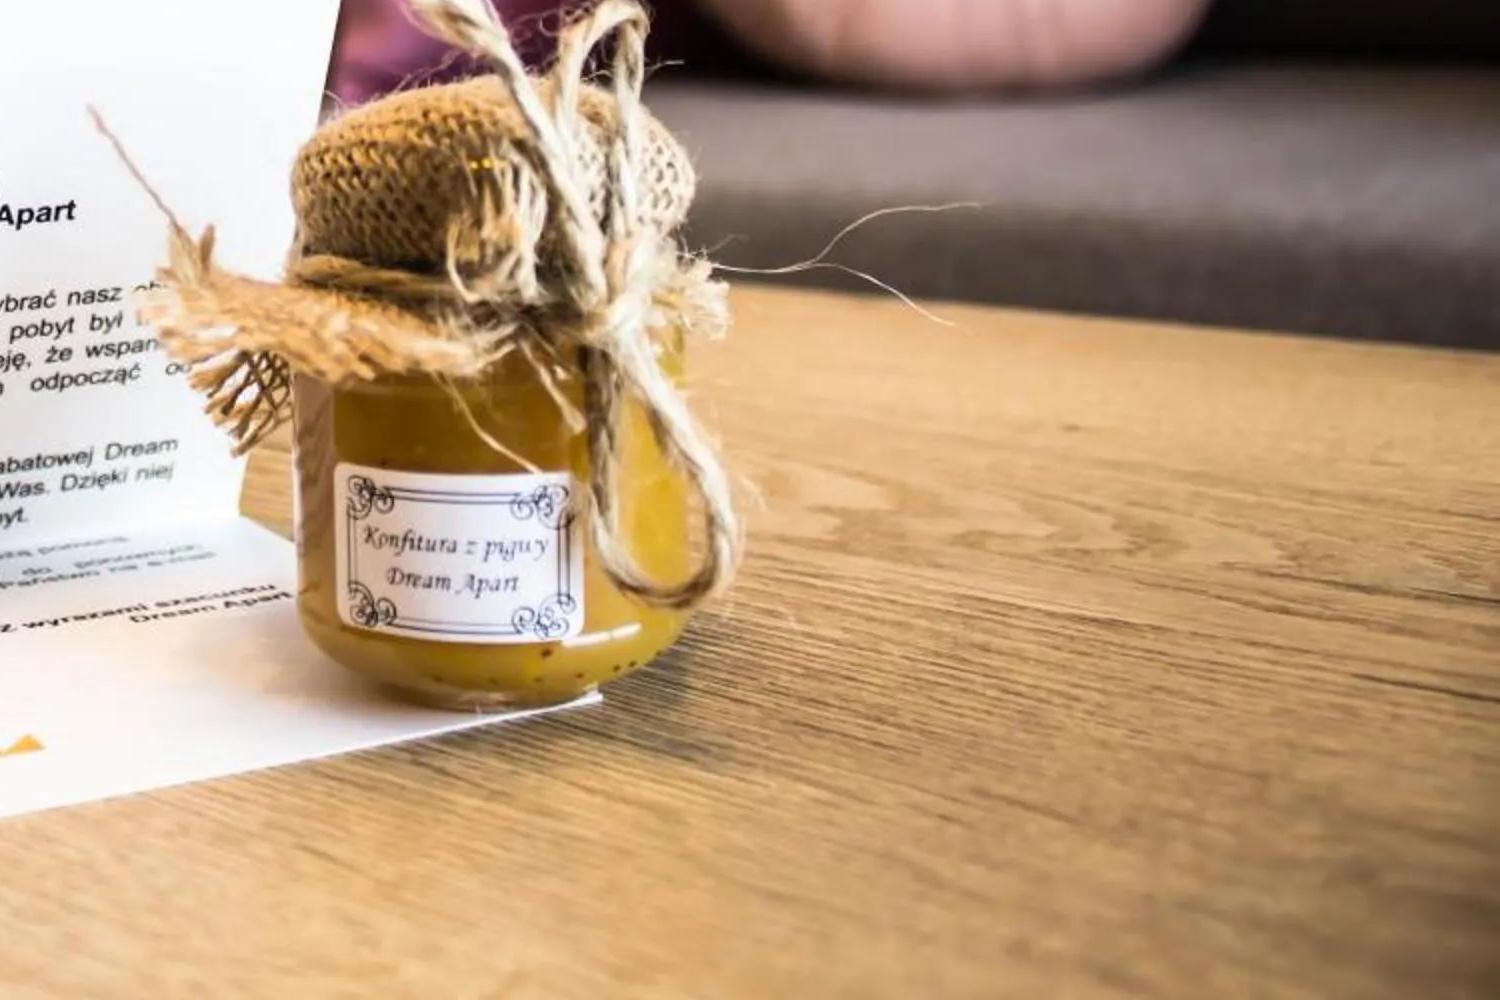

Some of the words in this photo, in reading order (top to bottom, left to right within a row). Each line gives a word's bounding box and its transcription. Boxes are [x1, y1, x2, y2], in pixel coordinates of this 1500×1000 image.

[67, 287, 123, 307] nasz
[9, 316, 75, 345] pobyt
[44, 345, 74, 364] że
[85, 337, 160, 360] wspan
[30, 362, 141, 393] odpocząć
[104, 439, 178, 461] Dream
[363, 525, 457, 556] Konfitura
[386, 567, 451, 592] Dream
[455, 573, 518, 598] Apart
